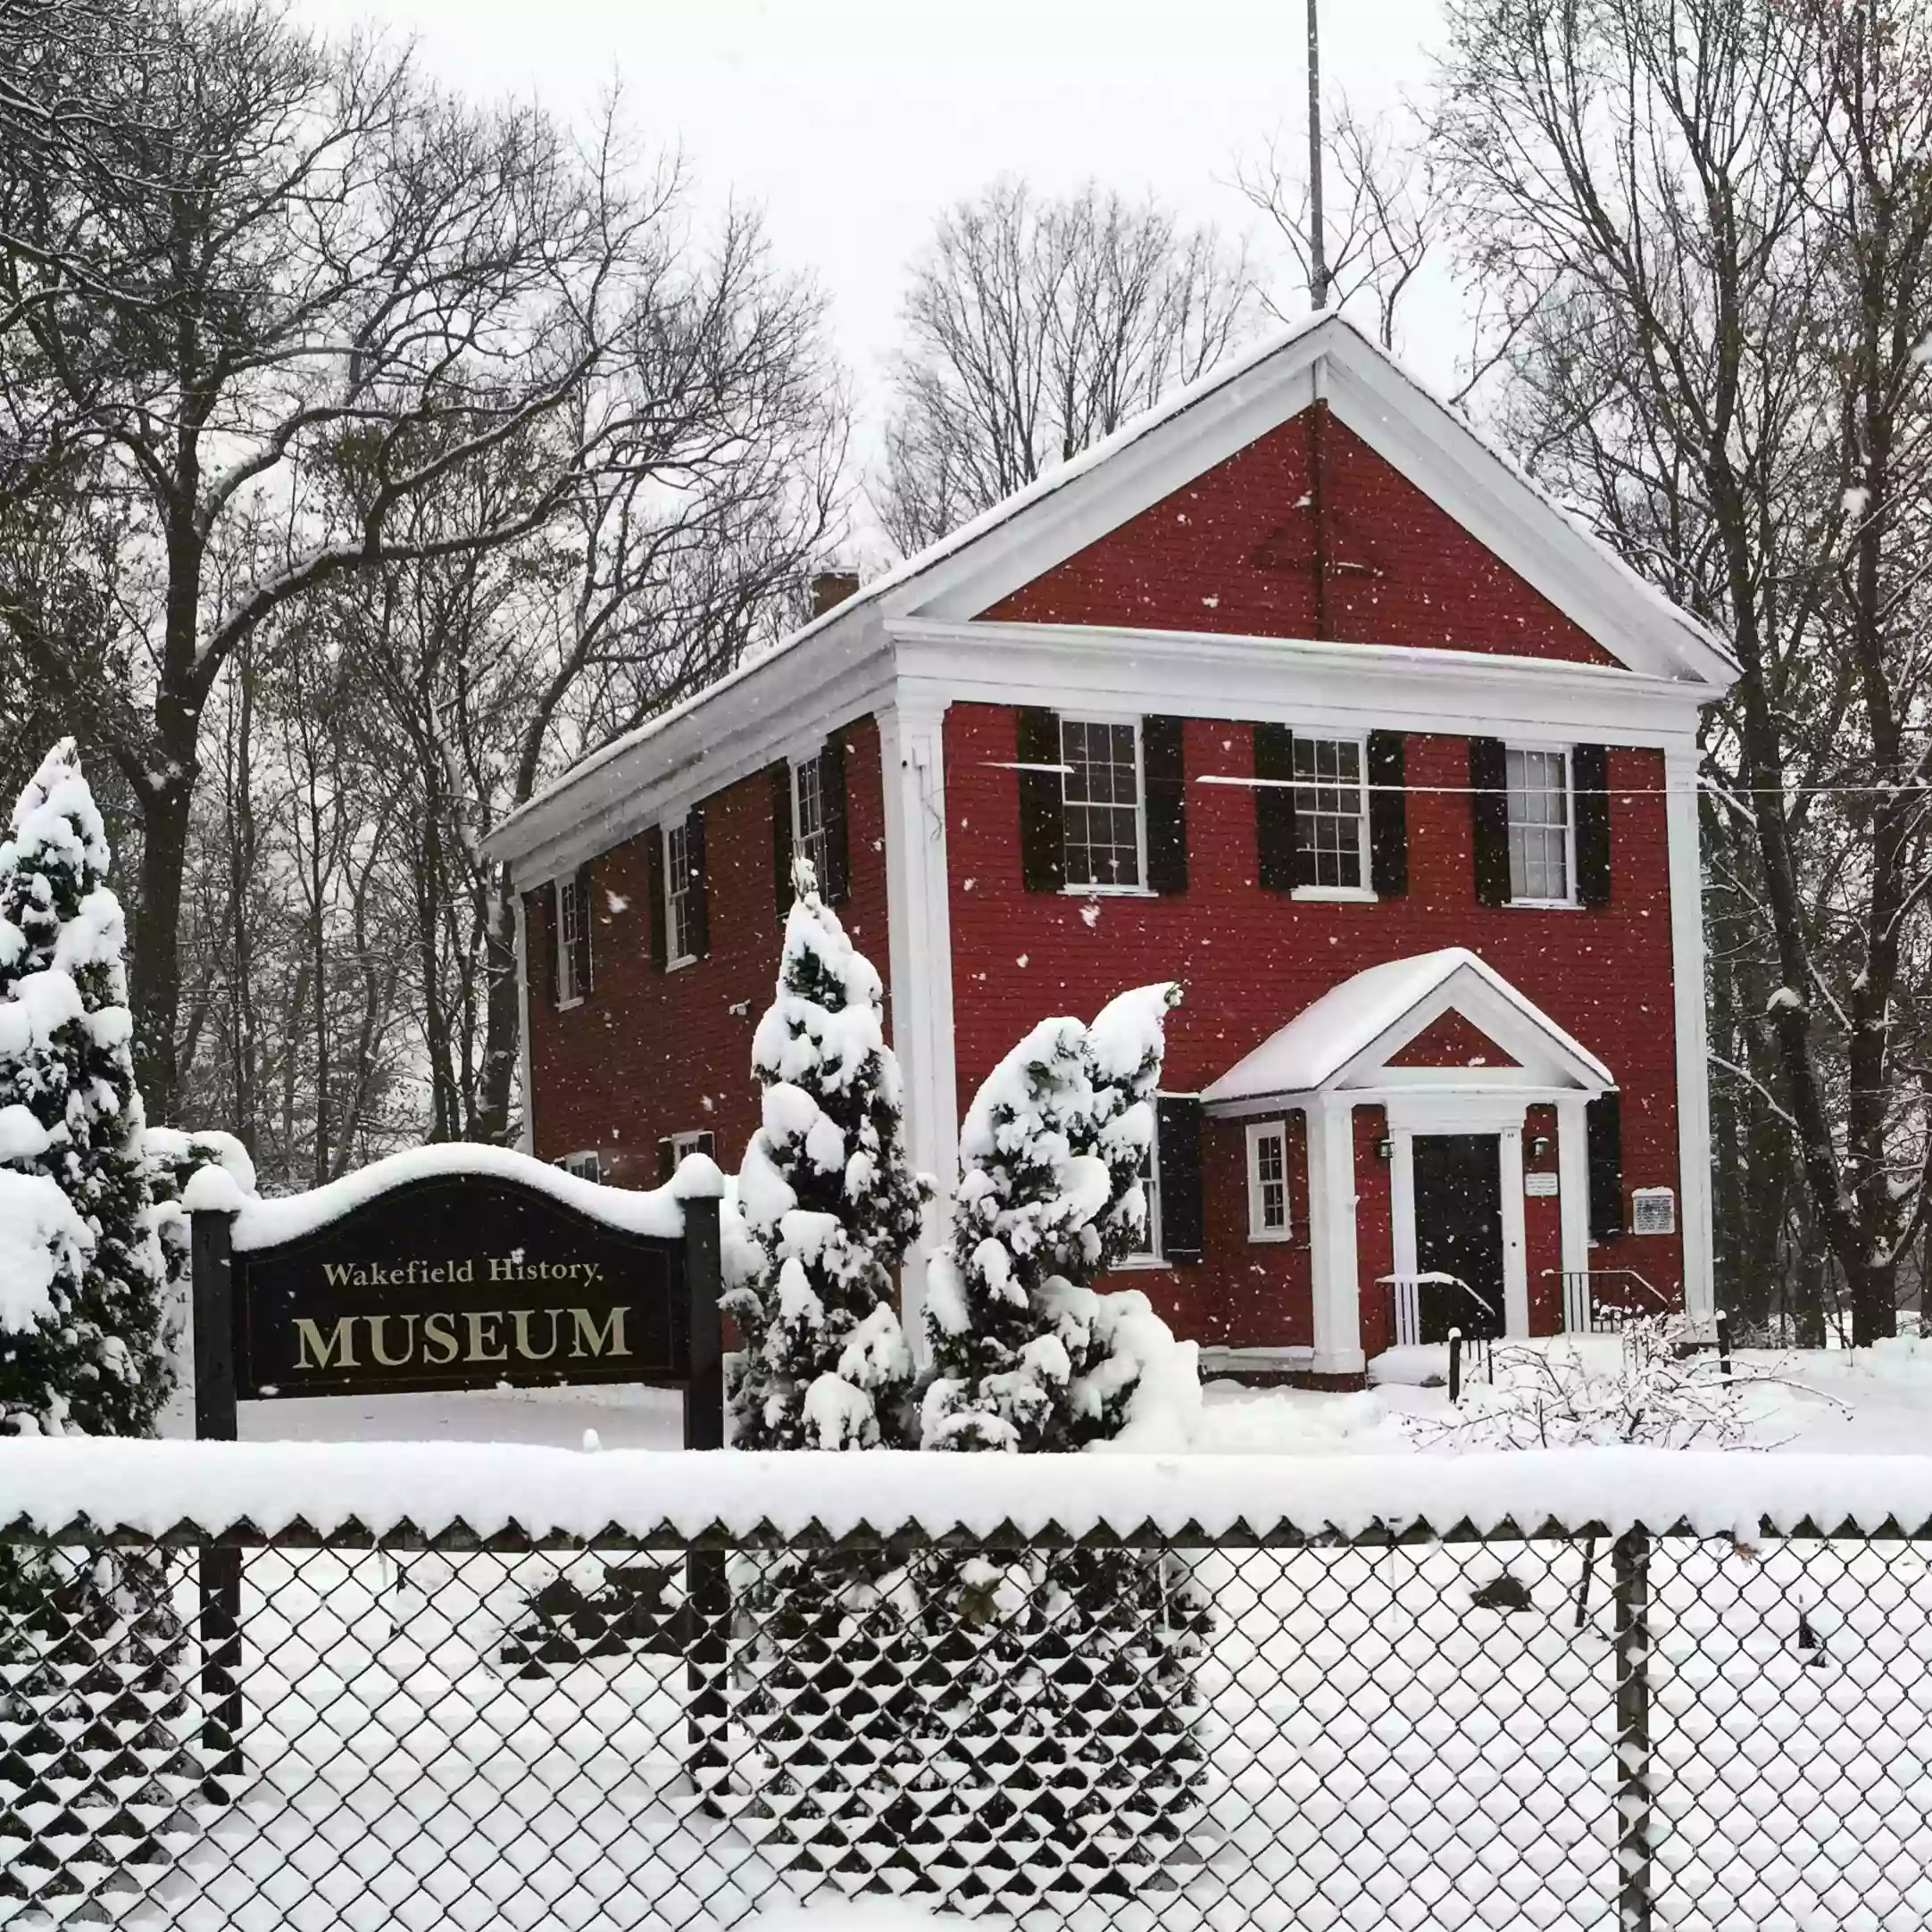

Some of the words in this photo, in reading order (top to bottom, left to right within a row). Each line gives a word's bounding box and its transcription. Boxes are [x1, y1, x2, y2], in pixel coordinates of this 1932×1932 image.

[321, 1259, 474, 1287] Wakefield
[487, 1257, 600, 1287] History
[292, 1306, 633, 1370] MUSEUM
